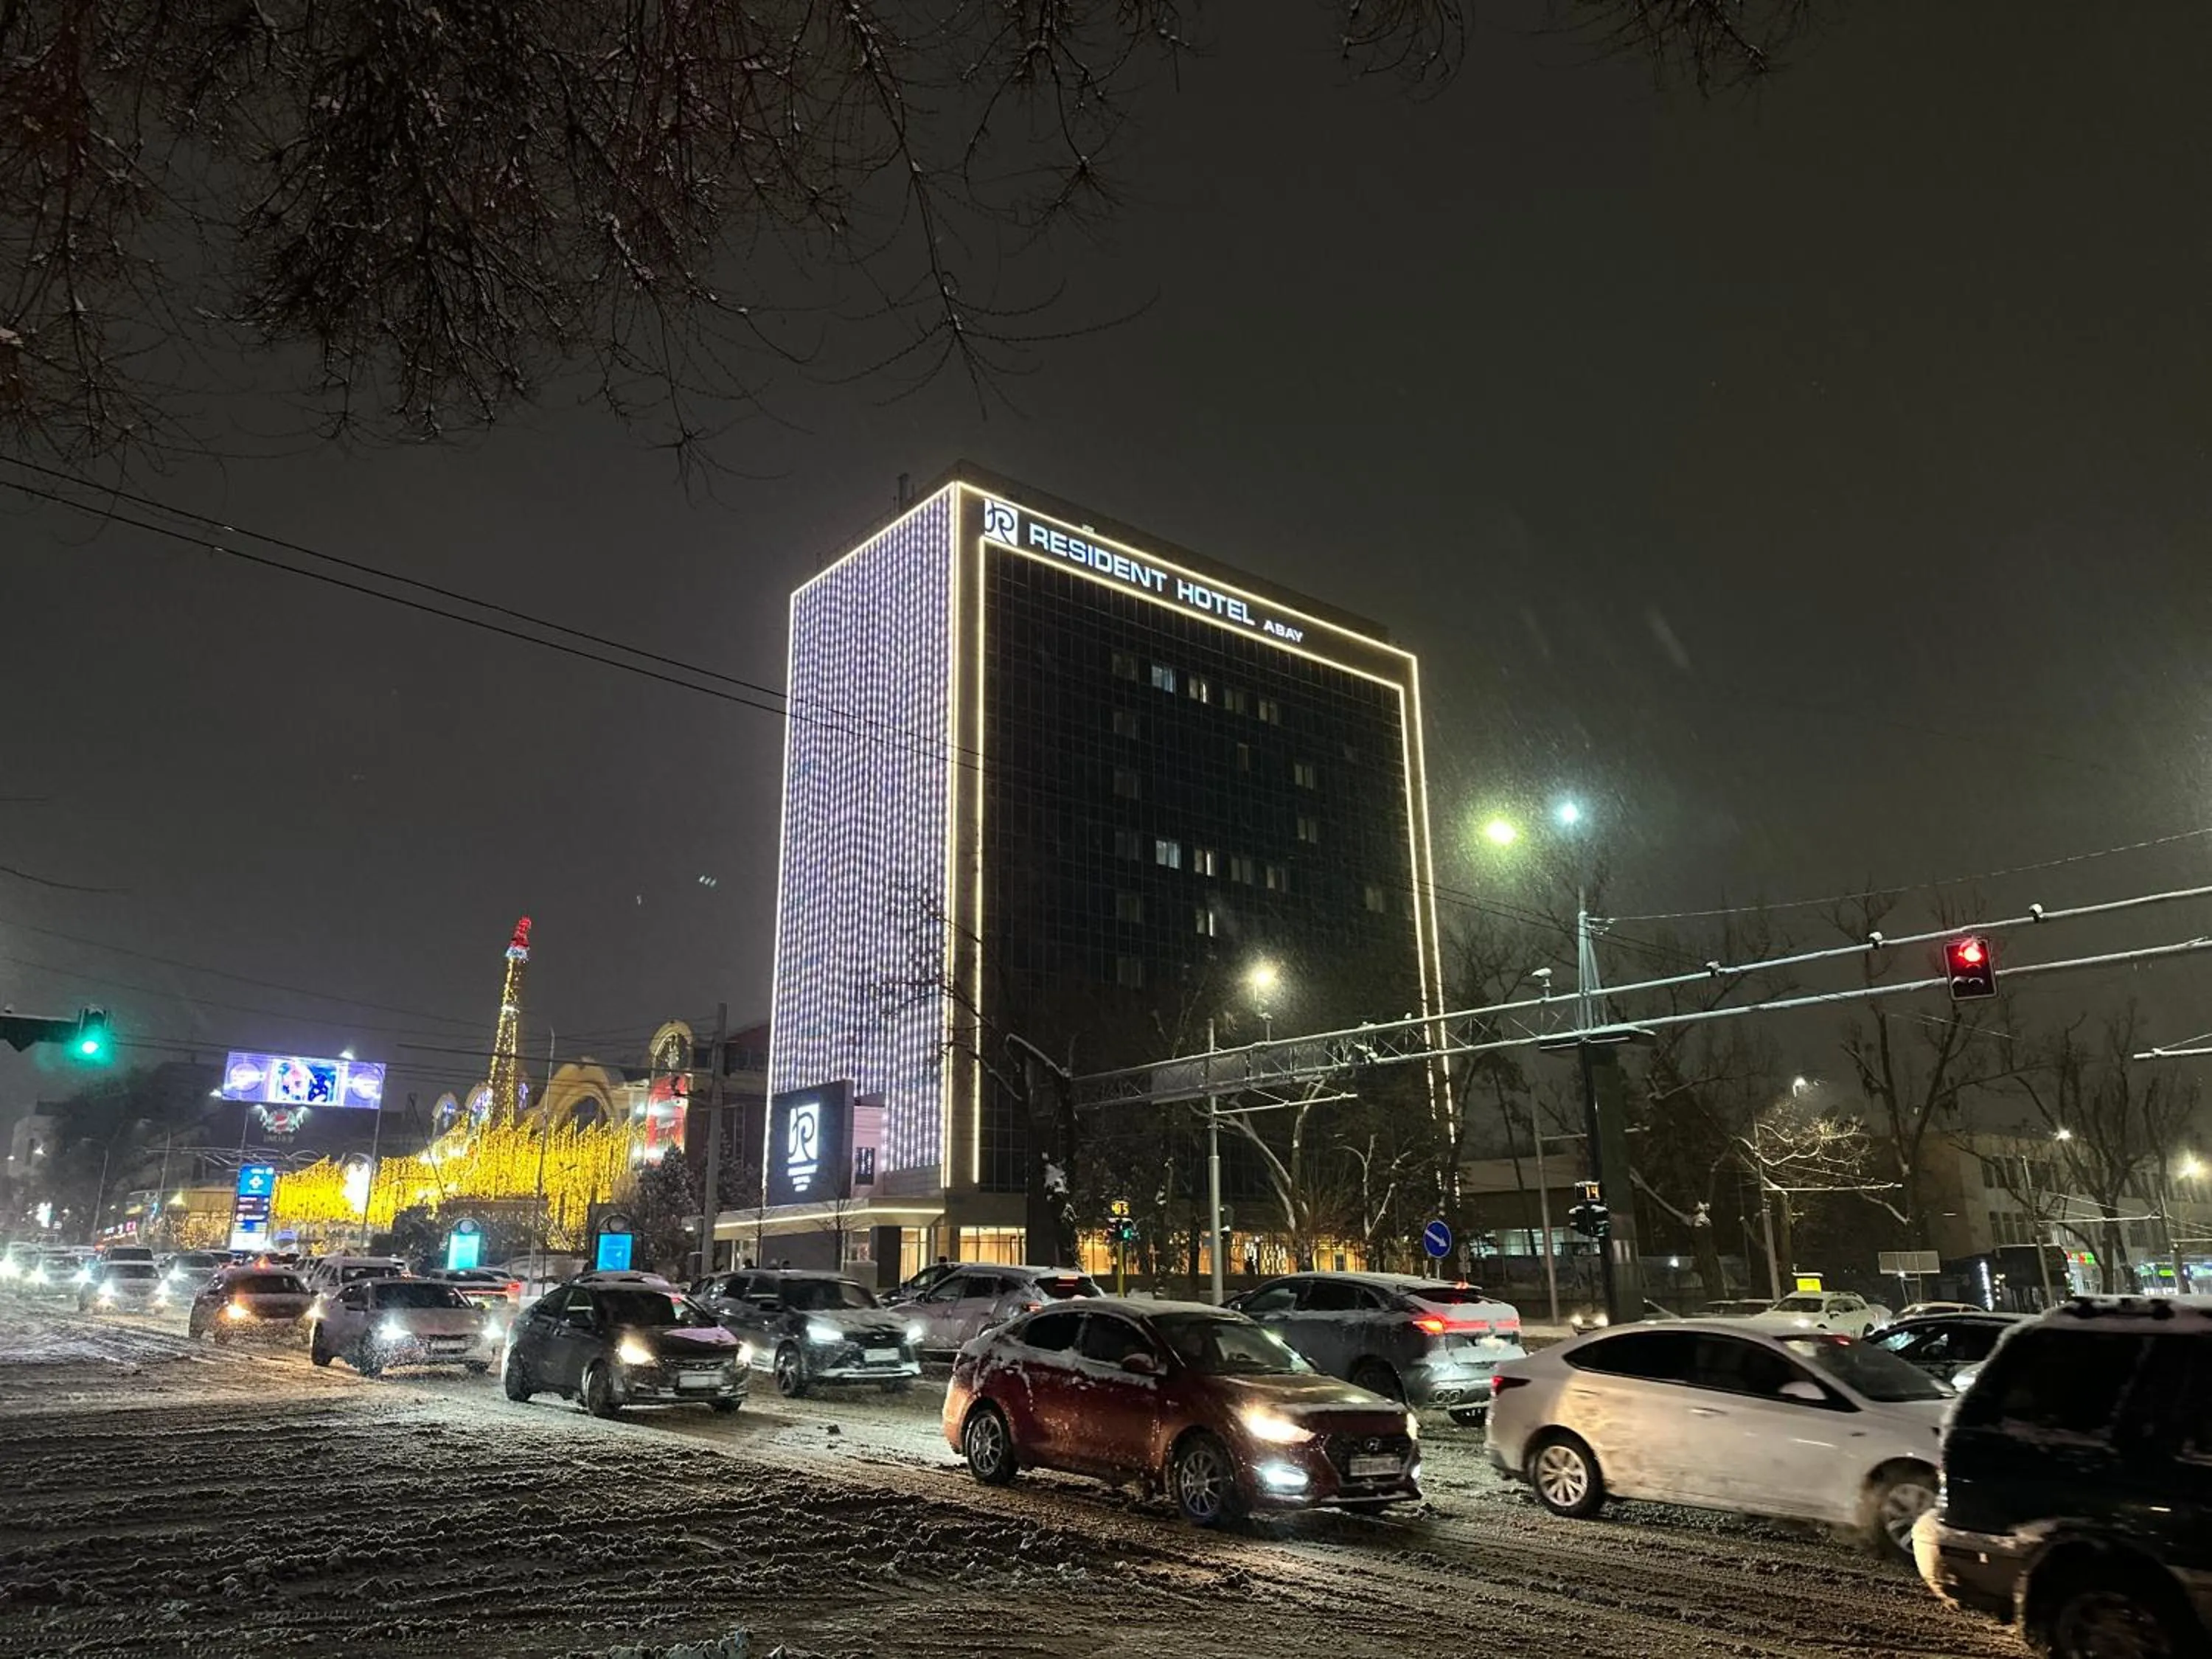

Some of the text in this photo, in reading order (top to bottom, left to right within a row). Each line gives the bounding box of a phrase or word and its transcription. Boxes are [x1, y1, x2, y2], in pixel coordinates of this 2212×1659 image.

[1029, 523, 1304, 643] RESIDENT HOTEL ABAY
[1586, 1186, 1599, 1198] 14
